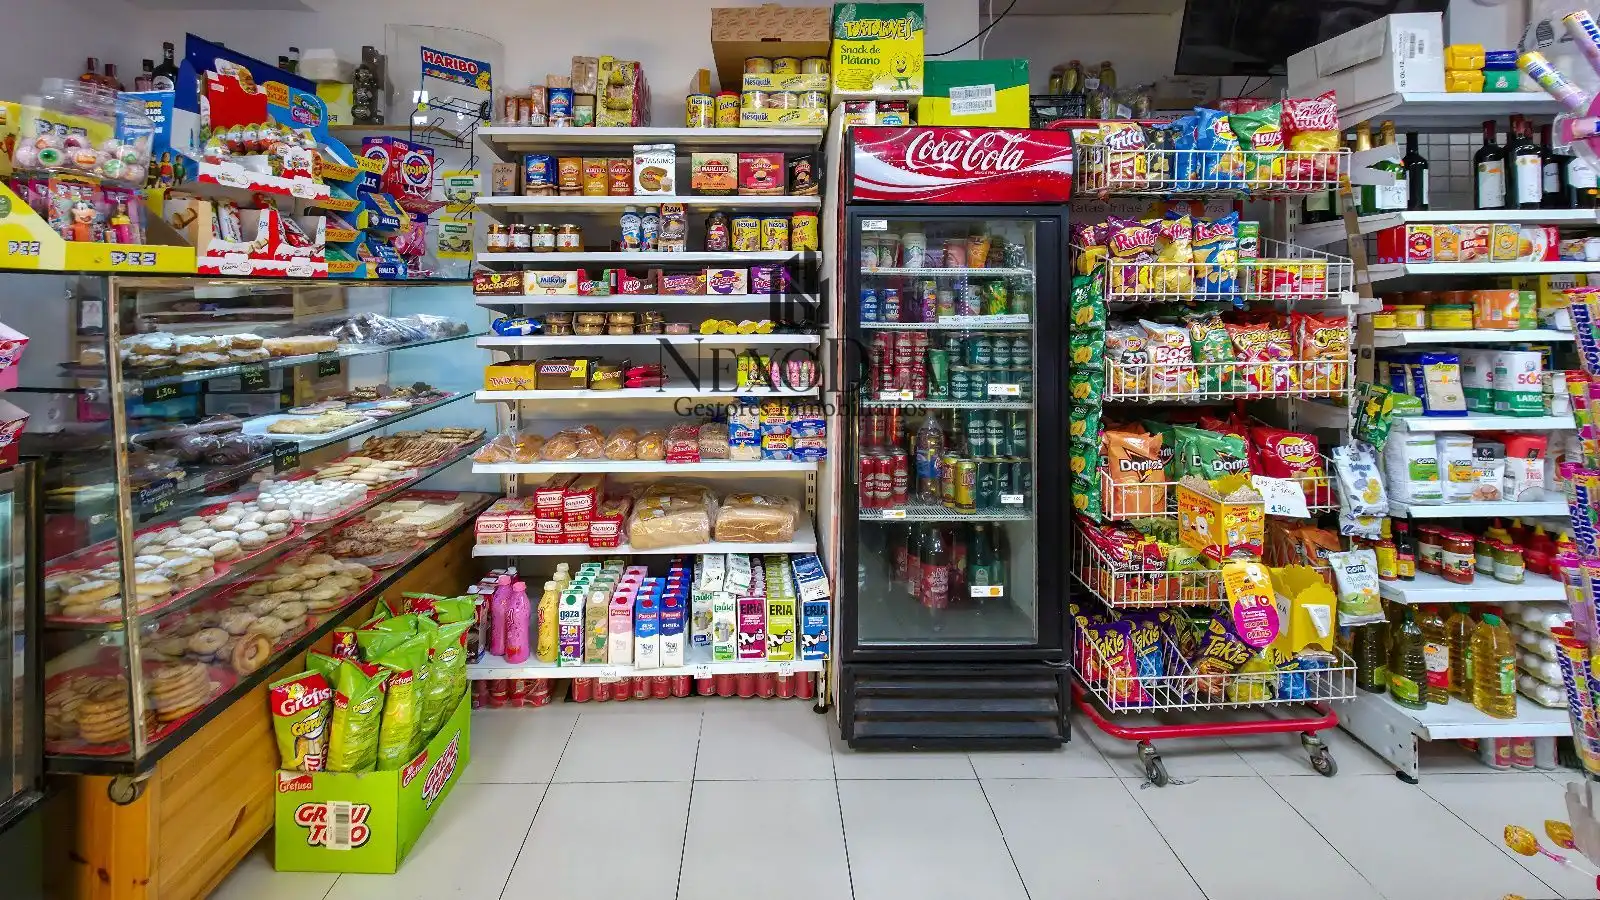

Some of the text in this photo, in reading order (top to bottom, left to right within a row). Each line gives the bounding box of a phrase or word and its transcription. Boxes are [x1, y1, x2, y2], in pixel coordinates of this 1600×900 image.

[841, 45, 880, 53] Snack de
[423, 50, 478, 75] HARIBO
[841, 54, 880, 65] Plátano
[905, 130, 1030, 171] Coca-Cola
[1119, 458, 1164, 474] Doritos
[769, 604, 793, 615] ERIA
[560, 610, 580, 621] gaza
[1203, 635, 1250, 664] Takis
[279, 781, 312, 792] Grefusa
